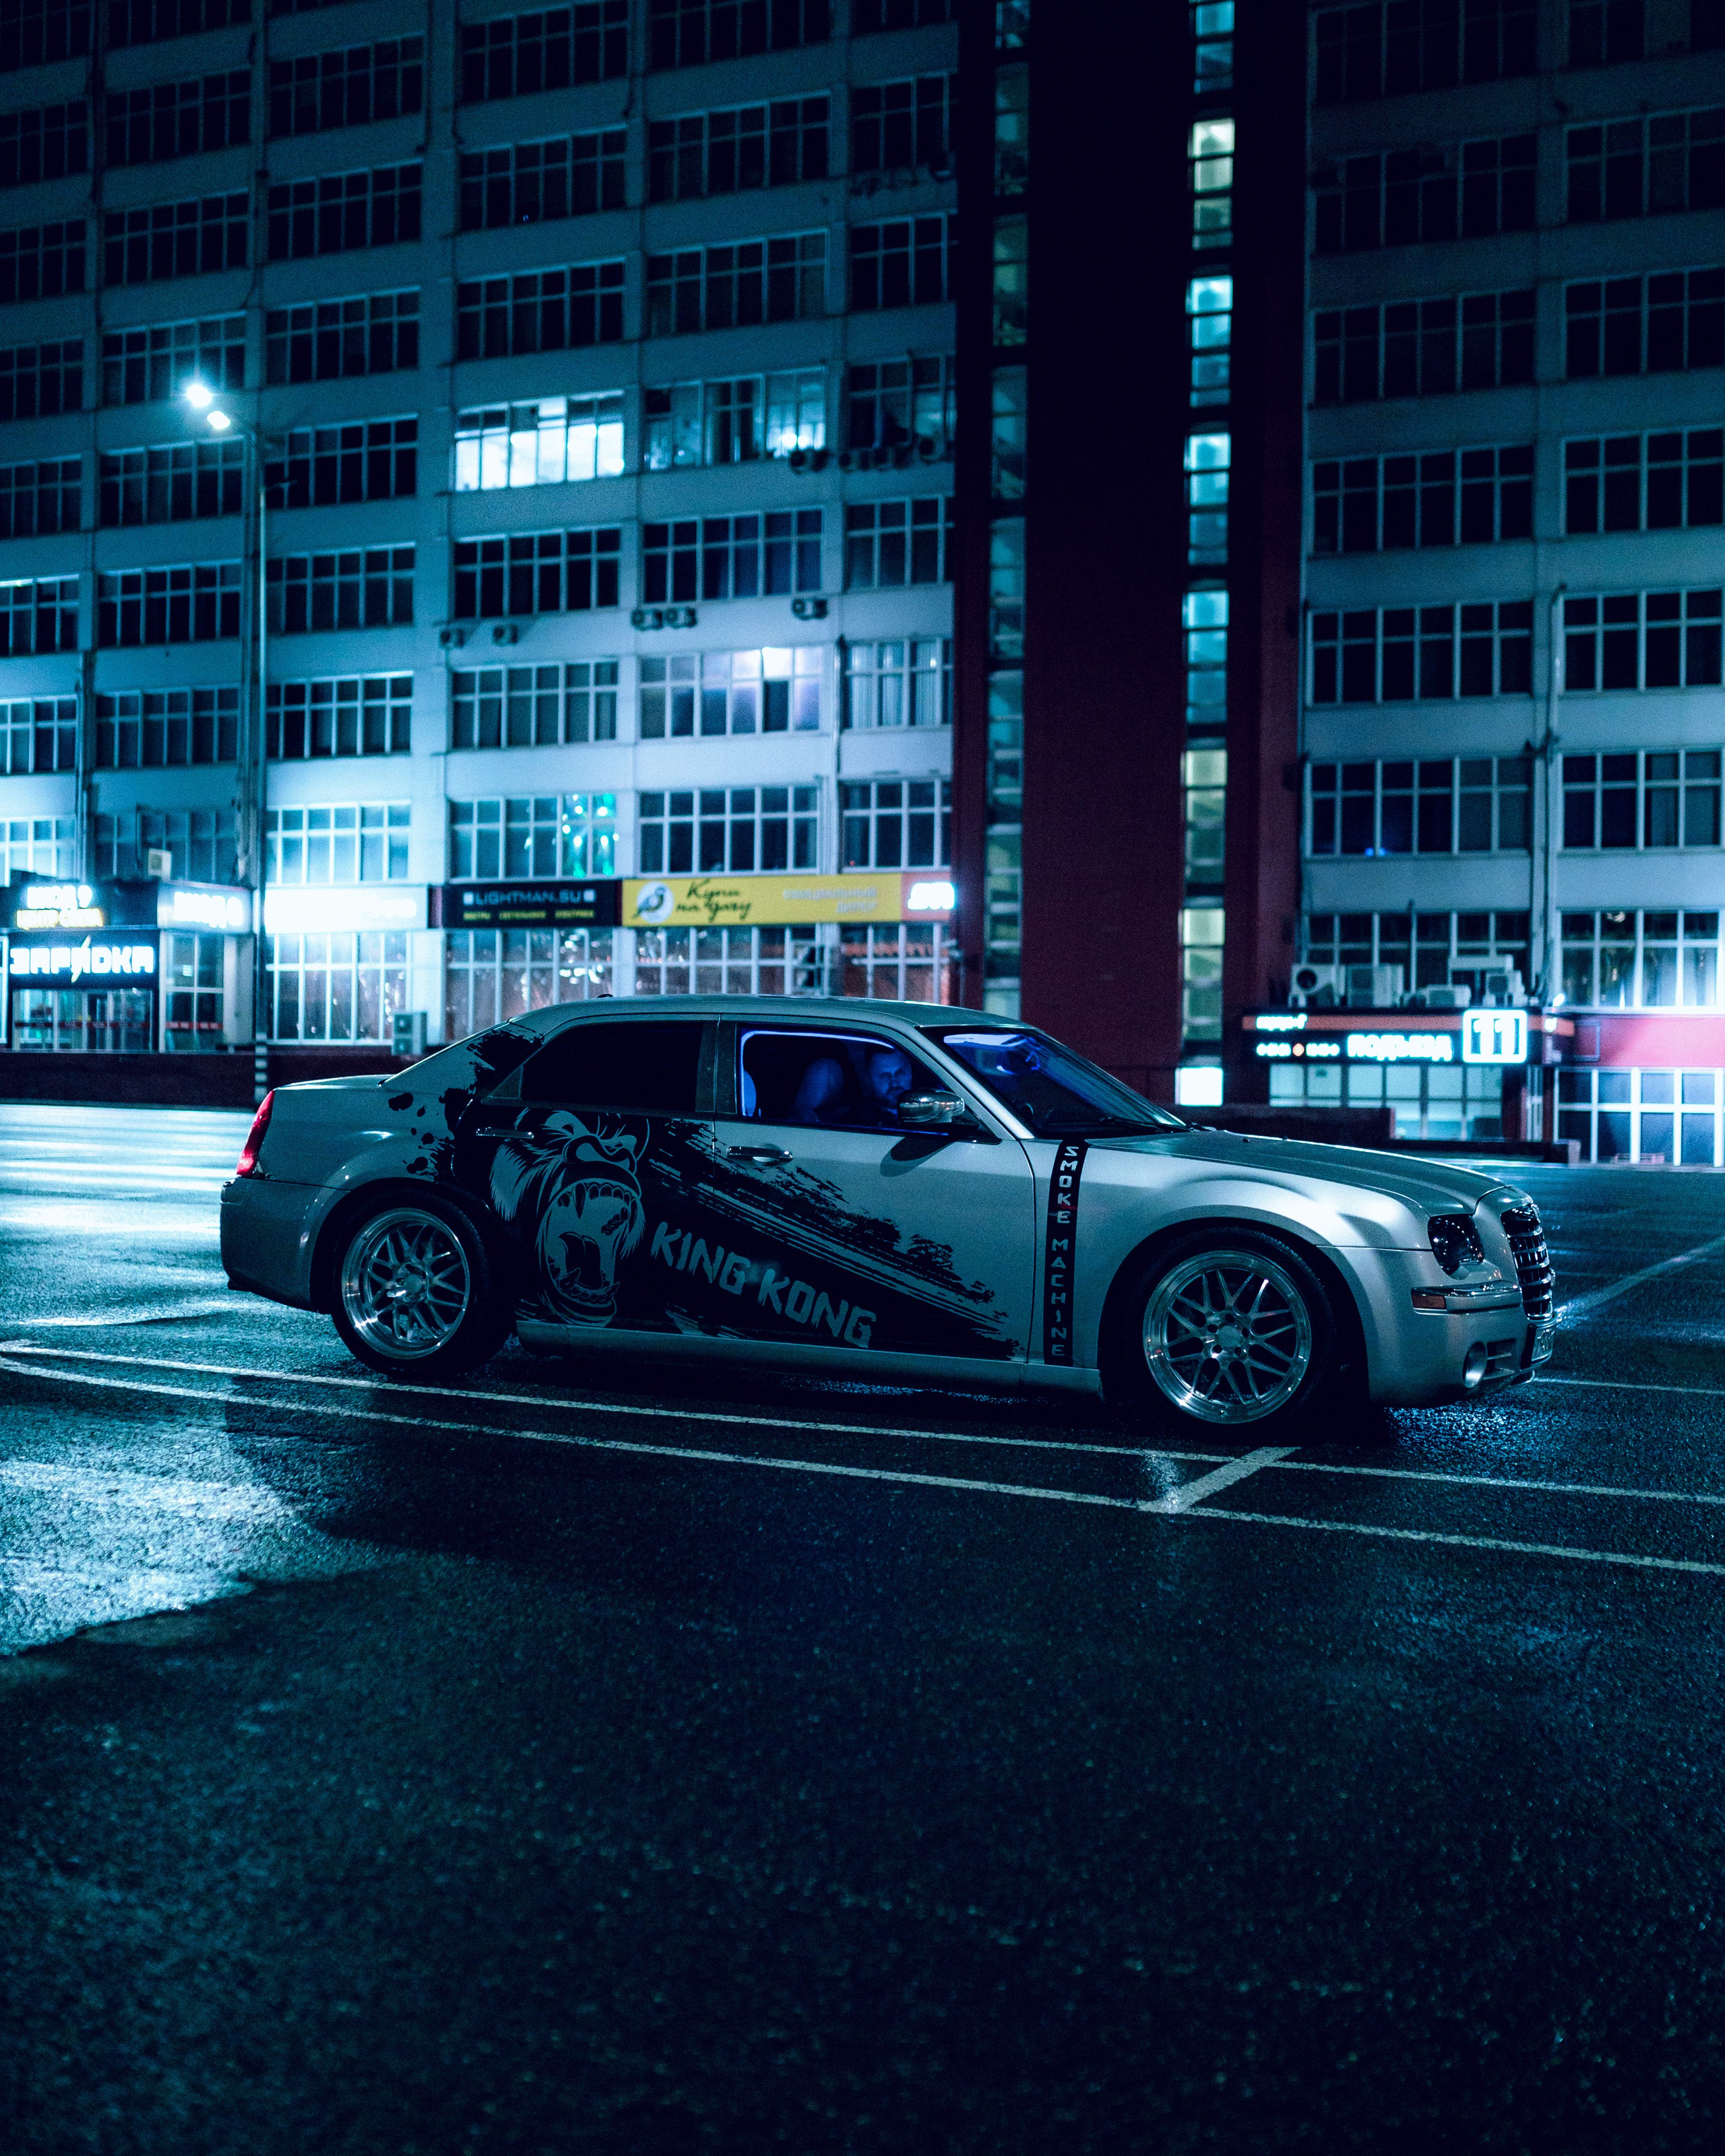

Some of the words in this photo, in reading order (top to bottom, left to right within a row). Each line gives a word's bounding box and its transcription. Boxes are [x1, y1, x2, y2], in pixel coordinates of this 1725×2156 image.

[474, 889, 582, 906] LIGHTMAN.SU
[1471, 1015, 1517, 1057] 11
[1057, 1146, 1079, 1224] SMOKE
[650, 1221, 752, 1295] KING
[757, 1268, 877, 1348] KONG
[1050, 1238, 1069, 1356] MACHINE
